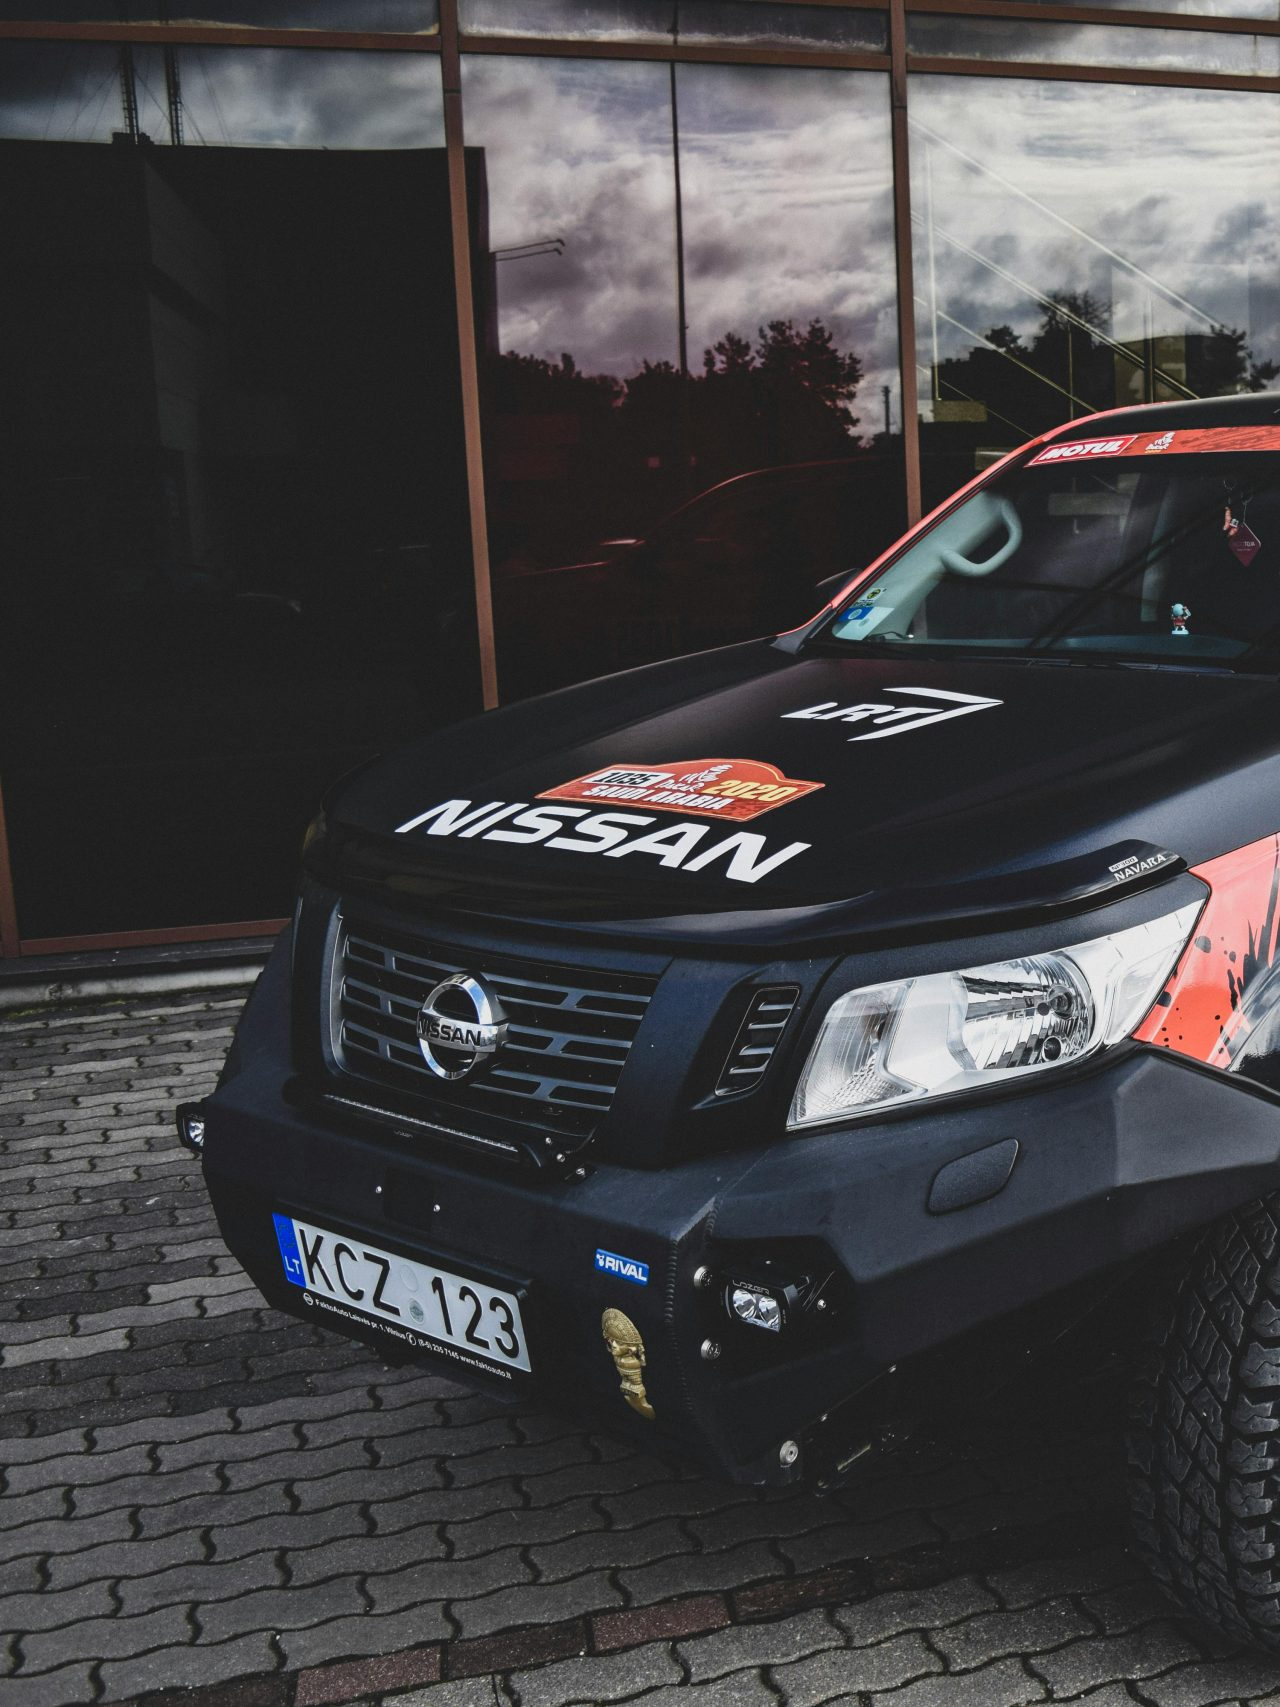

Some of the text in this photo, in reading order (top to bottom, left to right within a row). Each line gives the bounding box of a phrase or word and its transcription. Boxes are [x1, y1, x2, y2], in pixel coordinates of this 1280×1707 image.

[1039, 440, 1124, 461] MOTUL
[582, 785, 735, 810] SAUDI ARABIA
[594, 771, 661, 786] 1035
[702, 780, 798, 801] 2020
[395, 799, 812, 884] NISSAN
[1114, 854, 1167, 881] NAVARA
[419, 1019, 482, 1047] NISSAN
[604, 1256, 648, 1282] RIVAL
[284, 1228, 520, 1359] LT KCZ 123
